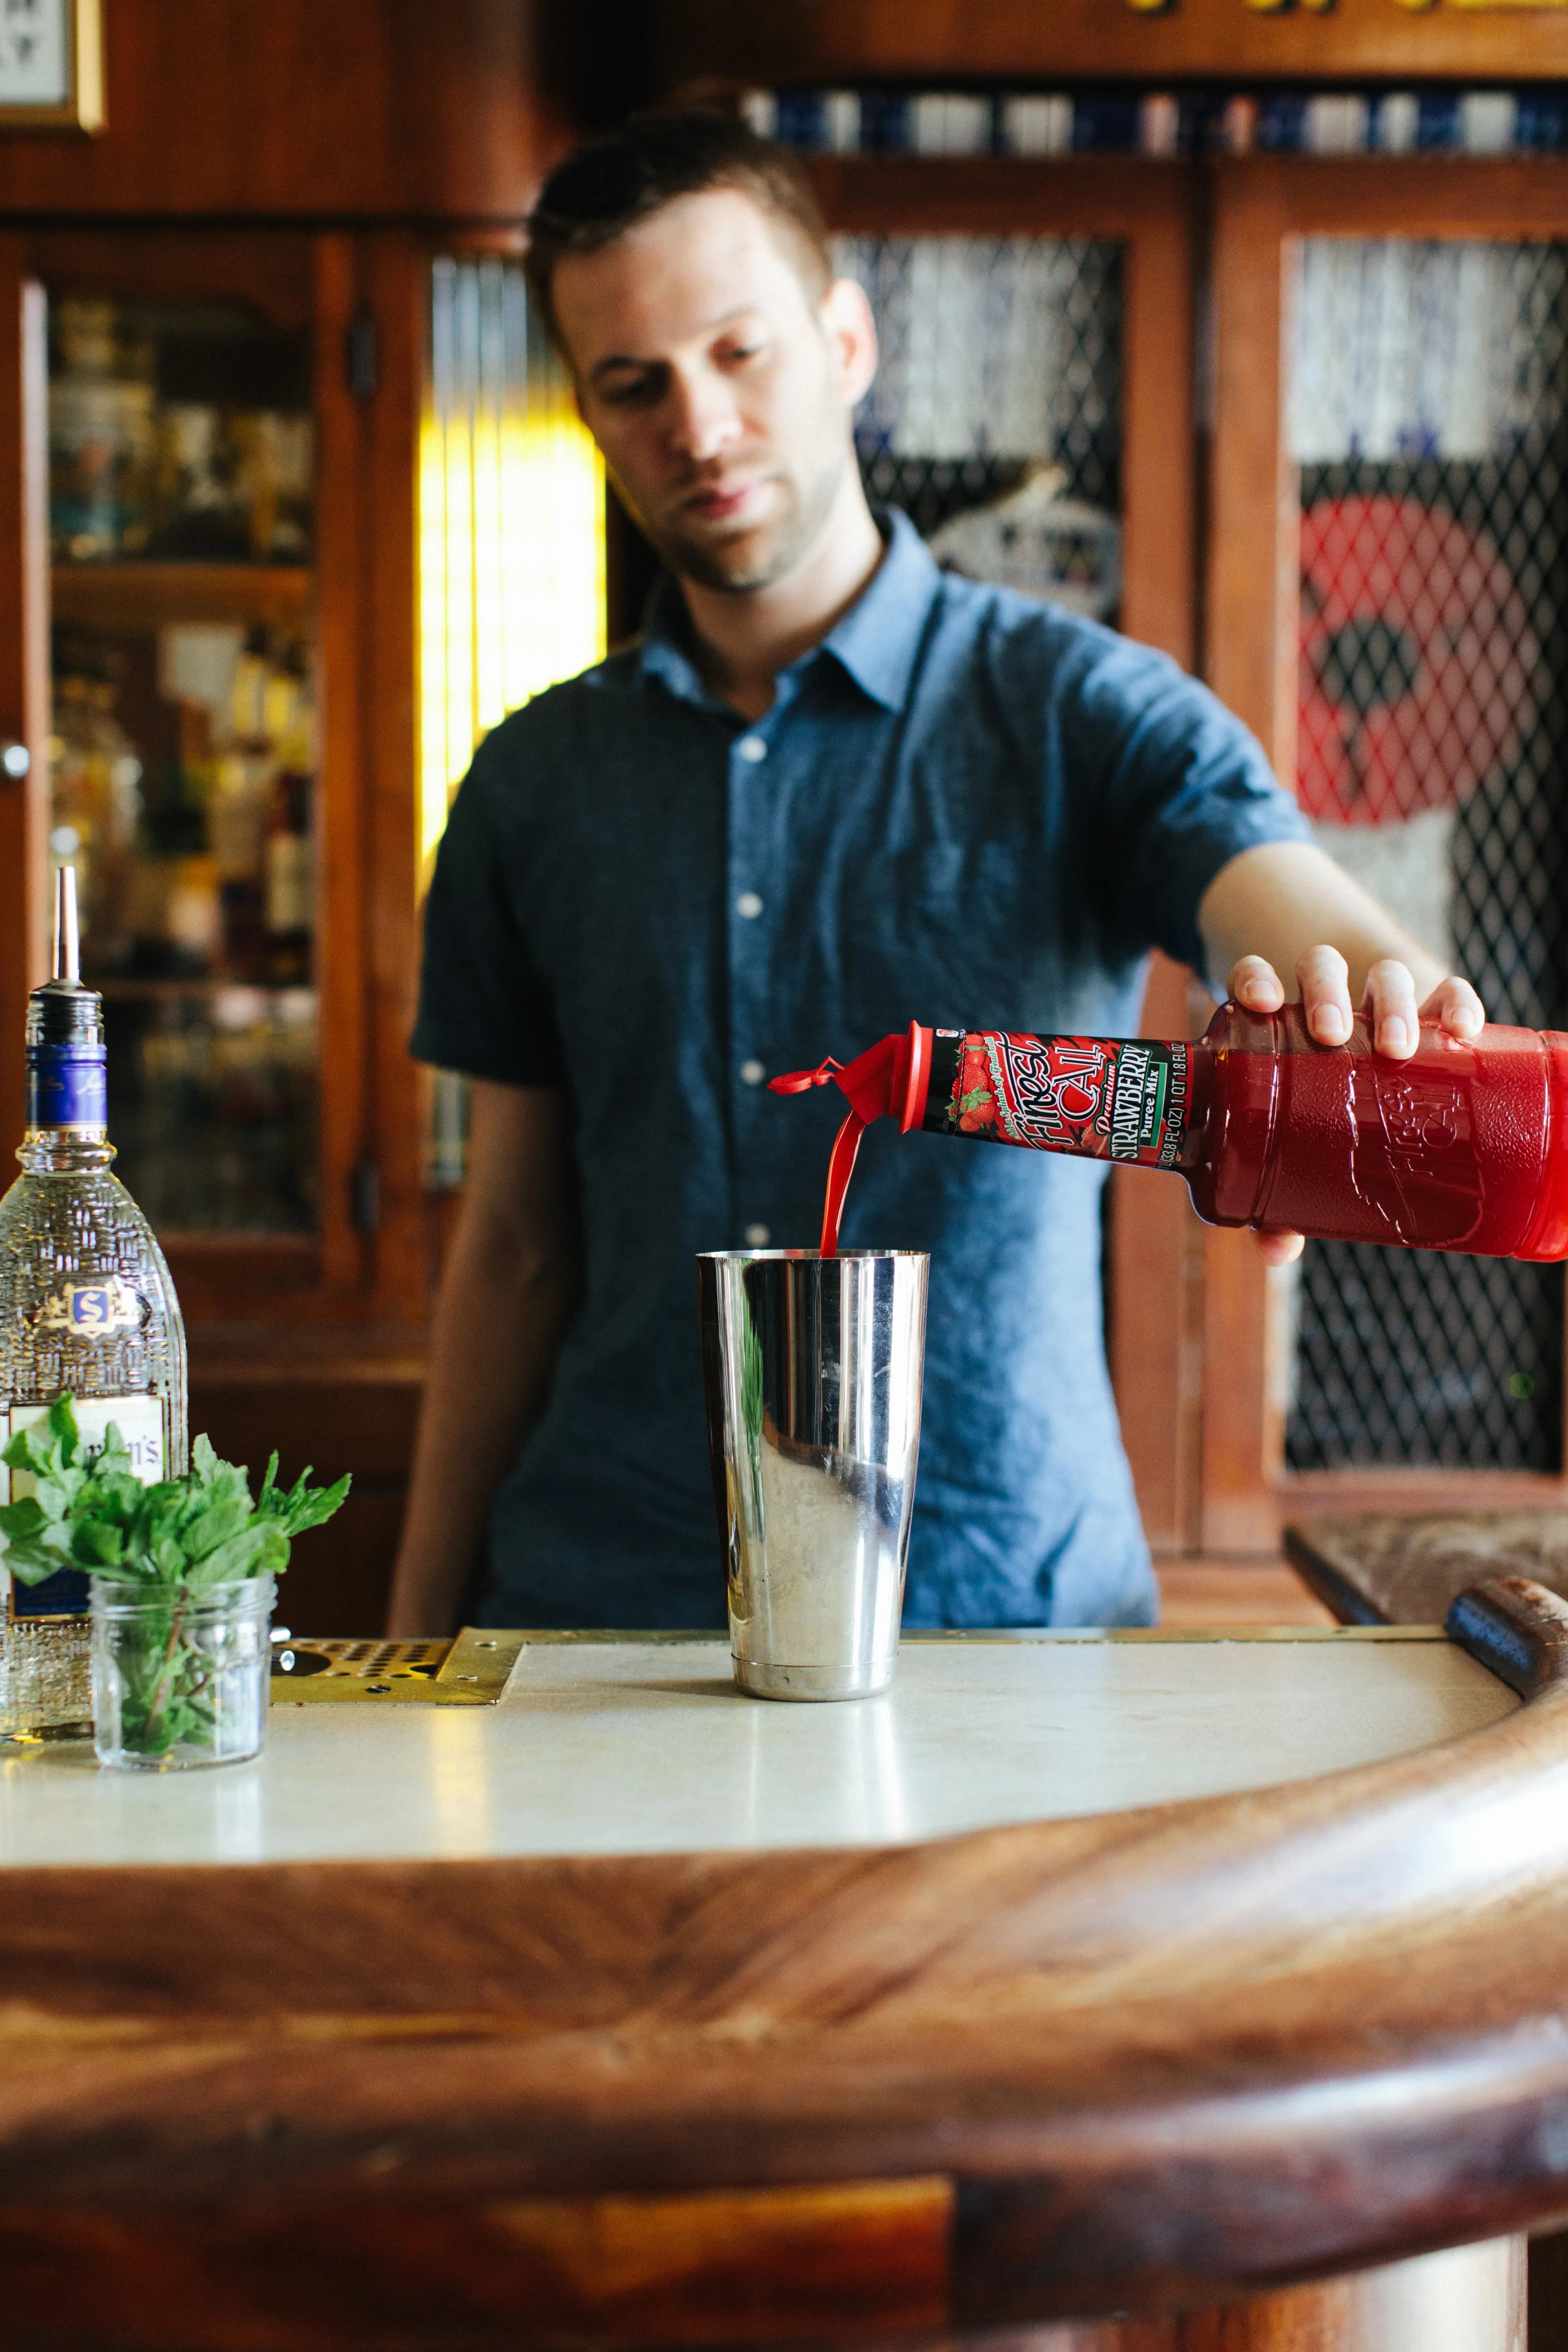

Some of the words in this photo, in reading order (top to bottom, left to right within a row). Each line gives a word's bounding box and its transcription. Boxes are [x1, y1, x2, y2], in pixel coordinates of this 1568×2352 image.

[984, 1036, 996, 1051] with
[1171, 1043, 1185, 1051] OZ
[989, 1051, 1002, 1076] Fruit
[1172, 1053, 1186, 1062] FL
[1173, 1063, 1186, 1076] 1.8
[991, 1076, 1004, 1087] of
[995, 1031, 1074, 1151] Finest
[1145, 1070, 1159, 1095] Mix
[1171, 1079, 1185, 1095] QT
[994, 1087, 1012, 1118] Splash
[1096, 1064, 1116, 1134] Premium
[1111, 1044, 1150, 1159] STRAWBERRY
[1140, 1098, 1155, 1138] Puree
[1167, 1107, 1185, 1127] OZ)
[1004, 1124, 1021, 1140] Add
[1165, 1130, 1179, 1142] FL
[1160, 1143, 1177, 1162] (33.8
[79, 1292, 104, 1323] S
